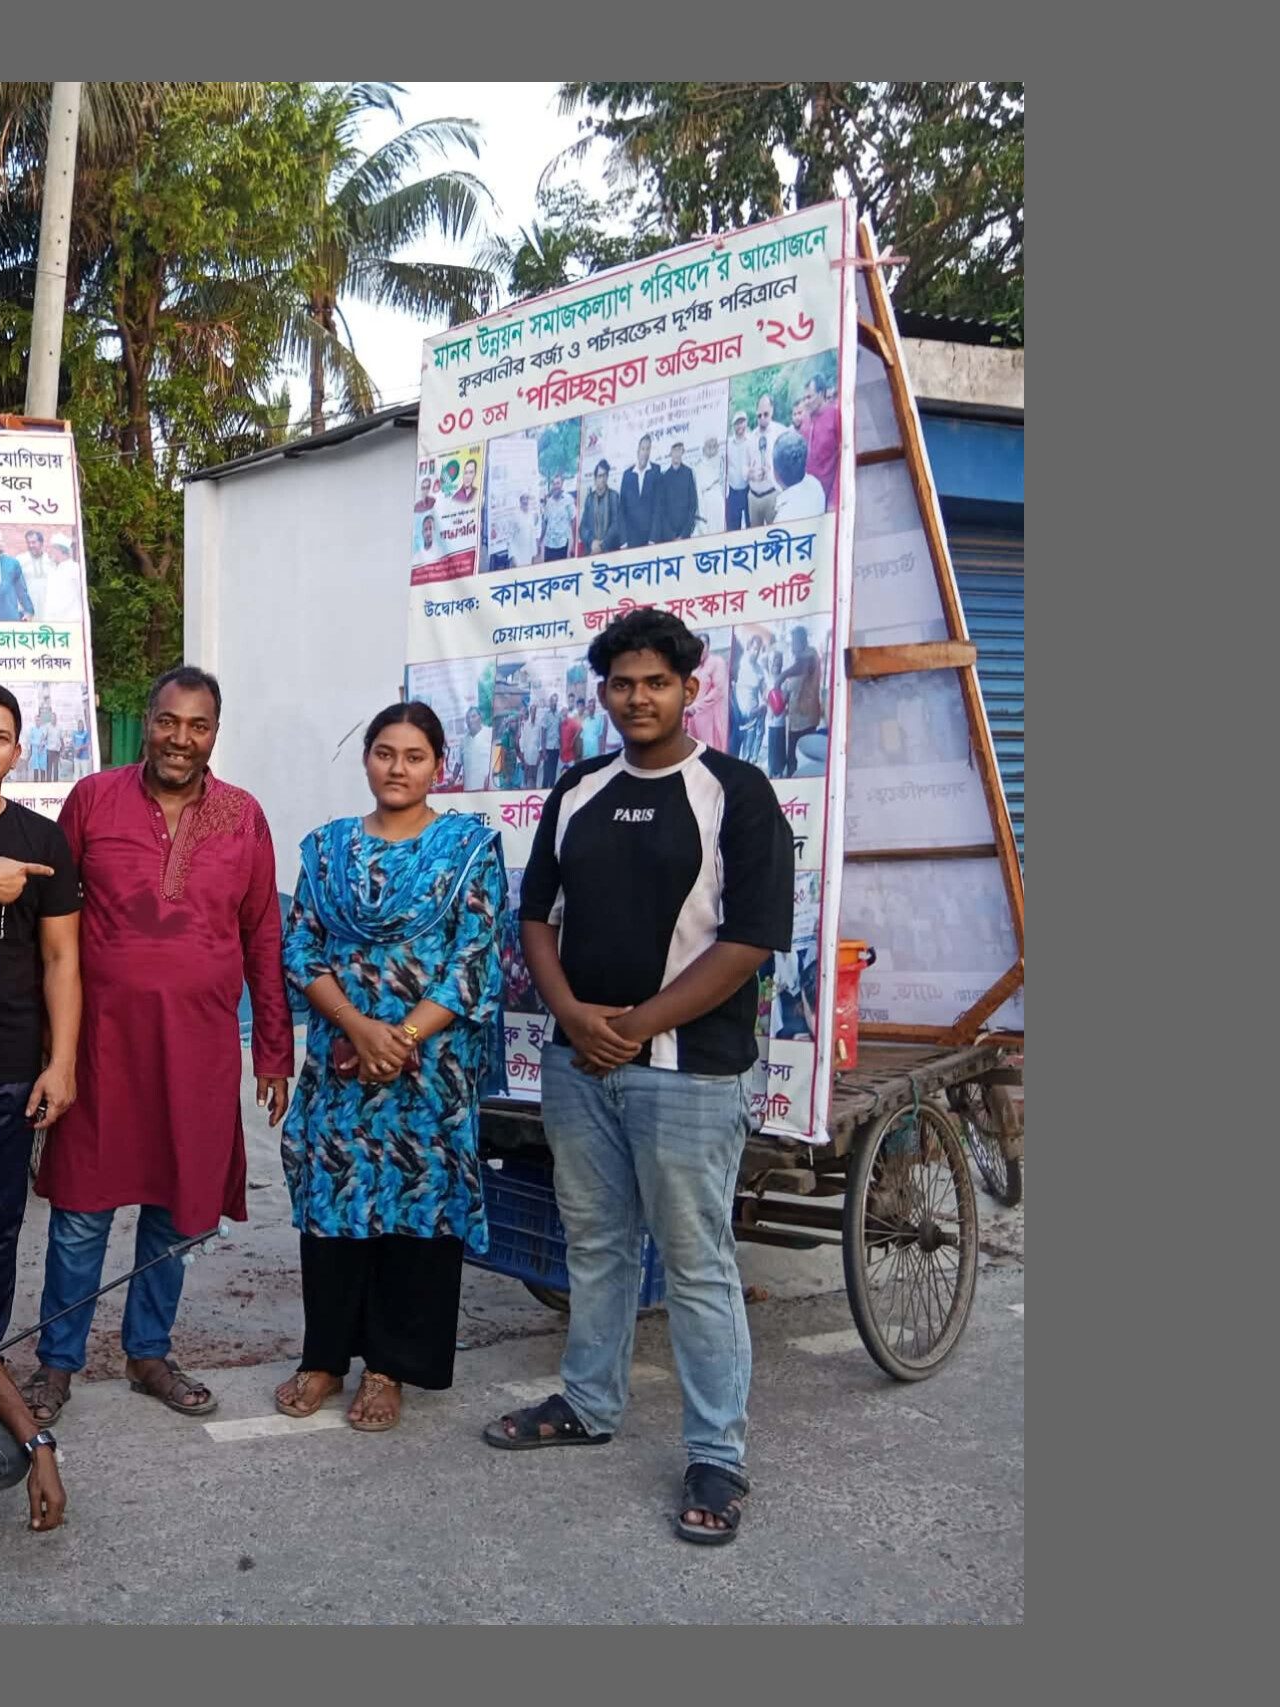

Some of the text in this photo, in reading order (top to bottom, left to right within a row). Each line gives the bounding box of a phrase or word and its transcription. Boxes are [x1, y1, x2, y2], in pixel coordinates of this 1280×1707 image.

[433, 337, 471, 370] মানব
[477, 320, 524, 358] উন্নয়ন
[530, 281, 633, 338] সমাজকল্যাণ
[739, 225, 828, 274] আয়োজনে
[458, 356, 526, 397] কুরবানীর
[530, 343, 564, 369] বর্জ্য
[568, 342, 580, 358] ও
[719, 275, 798, 313] পরিত্রানে
[438, 408, 473, 435] ৩০
[482, 401, 509, 425] তম
[655, 333, 743, 377] অভিযান
[490, 572, 583, 609] কামরুল
[591, 554, 684, 594] ইসলাম
[694, 528, 817, 576] জাহাঙ্গীর
[493, 620, 574, 645] চেয়ারম্যান,
[665, 589, 748, 621] সংস্কার
[759, 569, 816, 608] পার্টি
[31, 654, 71, 670] পরিষদ
[613, 808, 655, 822] PARIS
